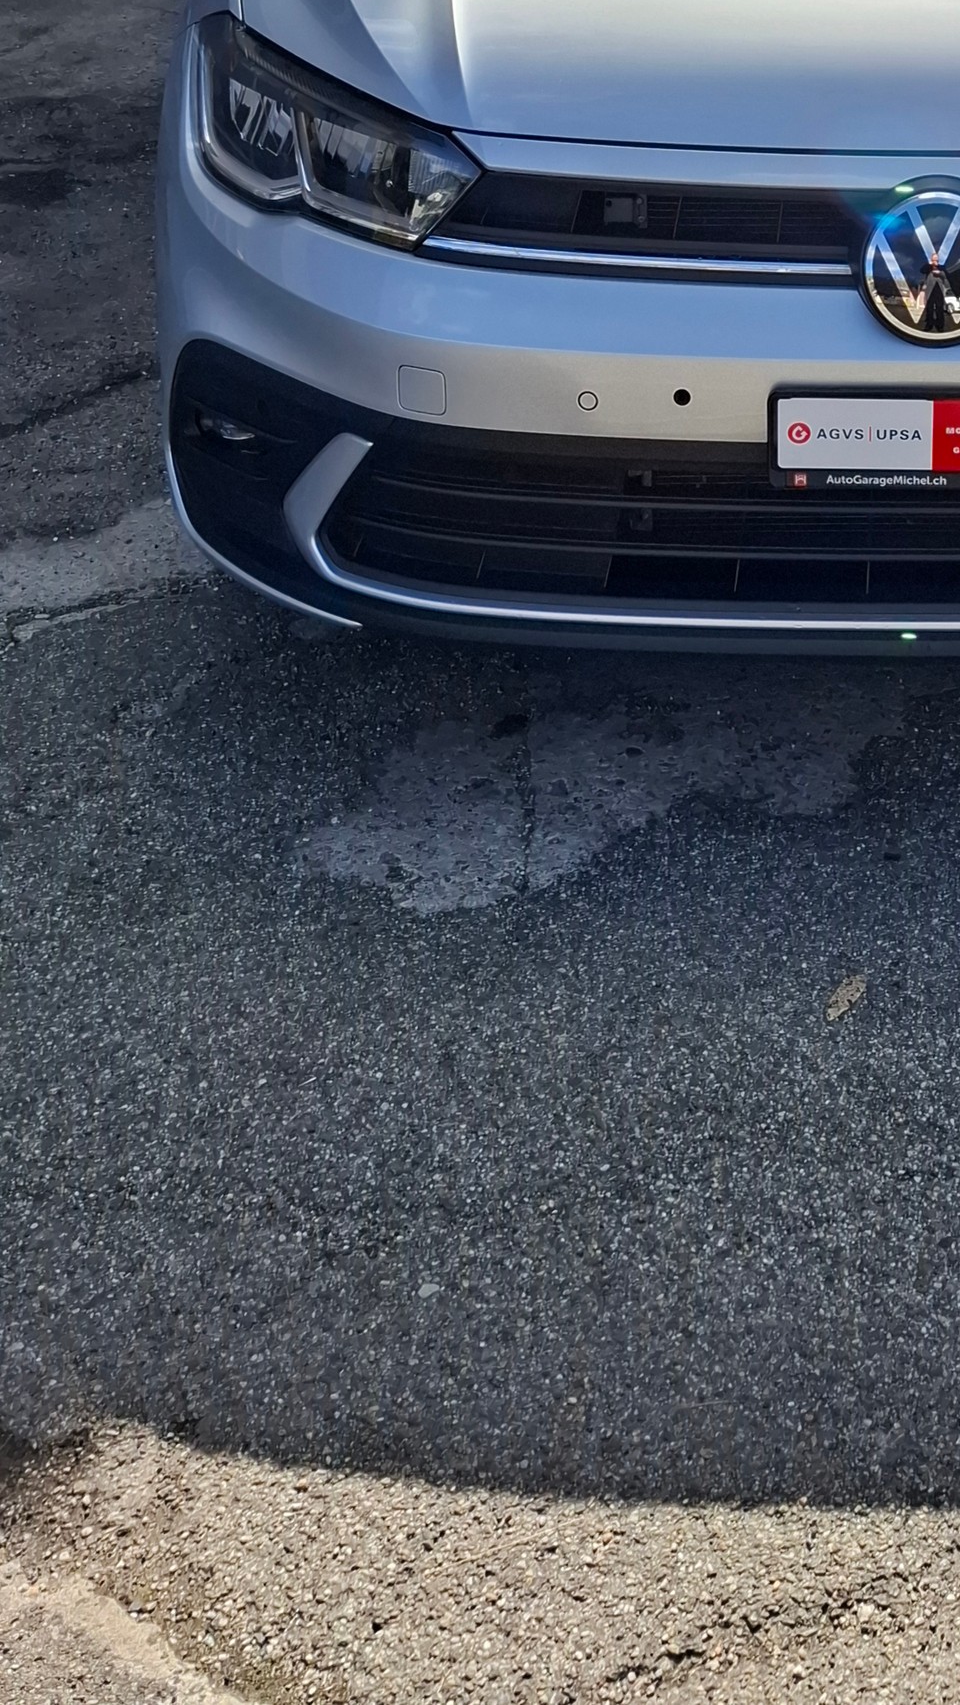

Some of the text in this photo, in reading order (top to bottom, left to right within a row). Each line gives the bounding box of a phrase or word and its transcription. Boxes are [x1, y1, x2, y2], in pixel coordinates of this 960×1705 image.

[816, 428, 922, 441] AGVS UPSA
[826, 474, 947, 487] AutoGarageMichel.ch
